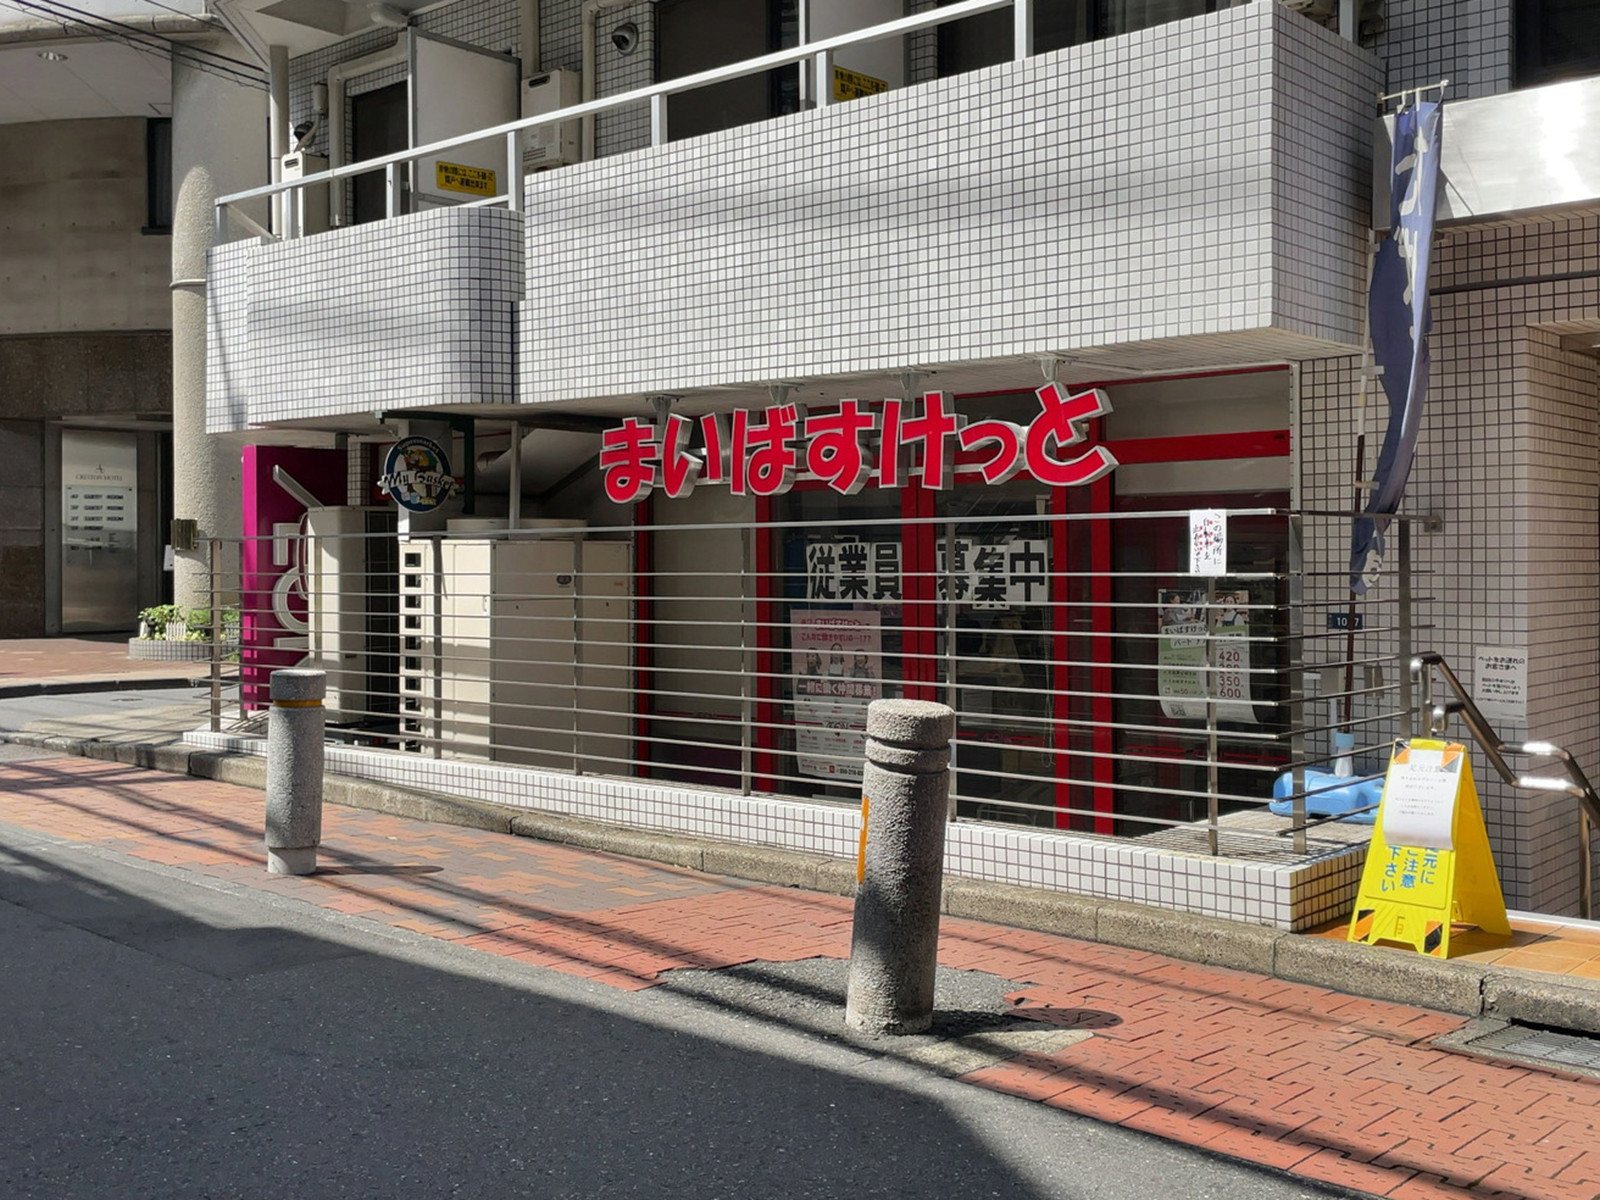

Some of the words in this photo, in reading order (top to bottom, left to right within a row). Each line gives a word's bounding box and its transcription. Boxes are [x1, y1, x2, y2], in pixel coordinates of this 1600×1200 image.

[599, 382, 1119, 504] まいばすけっと
[383, 471, 409, 487] My
[414, 469, 453, 489] Basket
[808, 544, 903, 600] 従業員
[937, 541, 1045, 608] 募集中
[1219, 651, 1240, 662] 420
[1219, 676, 1240, 687] 350
[1219, 687, 1241, 699] 600
[1381, 845, 1402, 893] 下さい
